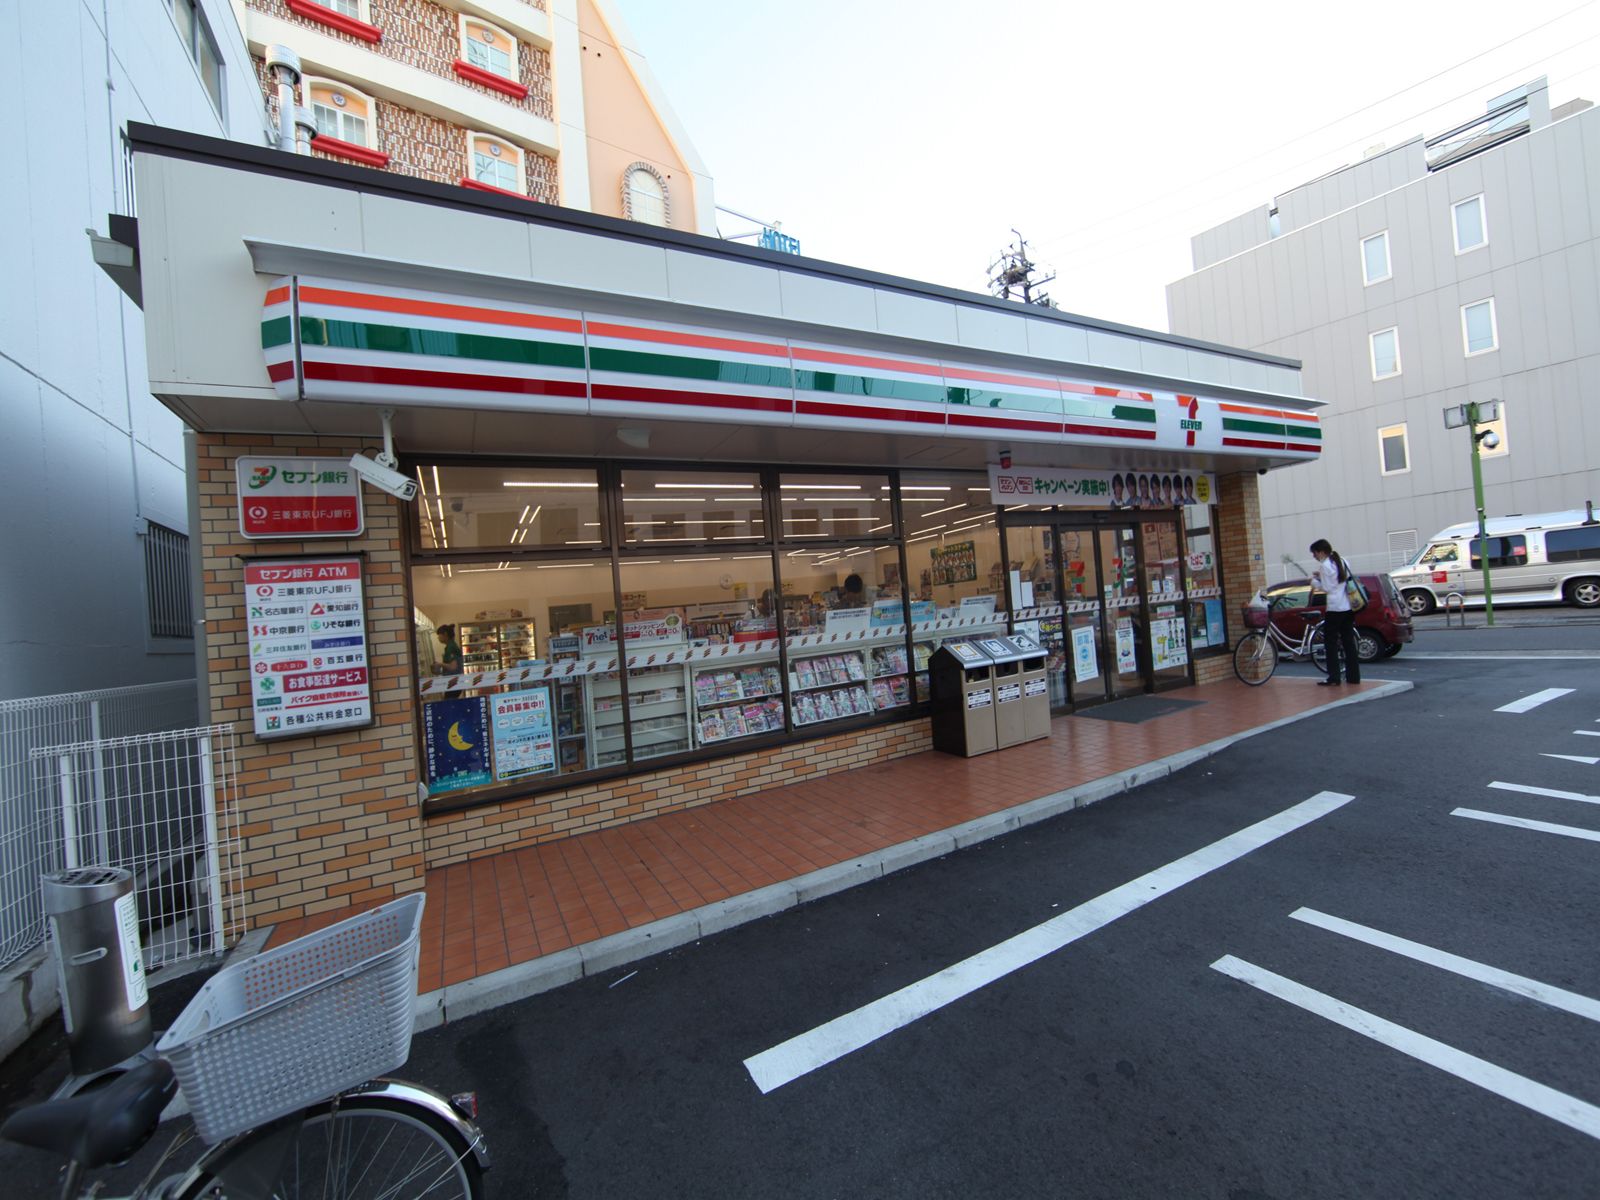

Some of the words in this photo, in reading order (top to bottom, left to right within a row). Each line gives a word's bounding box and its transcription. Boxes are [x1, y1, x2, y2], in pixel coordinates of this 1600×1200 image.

[1175, 394, 1199, 446] 7
[281, 470, 348, 484] セブン銀行
[272, 510, 352, 520] 三菱東京UFJ銀行
[260, 568, 313, 581] セブン銀行
[318, 566, 348, 577] ATM
[277, 585, 352, 597] 三菱東京UFJ銀行
[264, 606, 304, 616] 名古屋銀行
[326, 603, 359, 612] 愛知銀行
[322, 618, 360, 629] りそな銀行
[269, 625, 305, 635] 中京銀行
[266, 643, 306, 654] 三井住友銀行
[327, 654, 363, 665] 百五銀行
[498, 700, 545, 714] 会員募集中!!
[286, 708, 363, 725] 各種公共料金窓口
